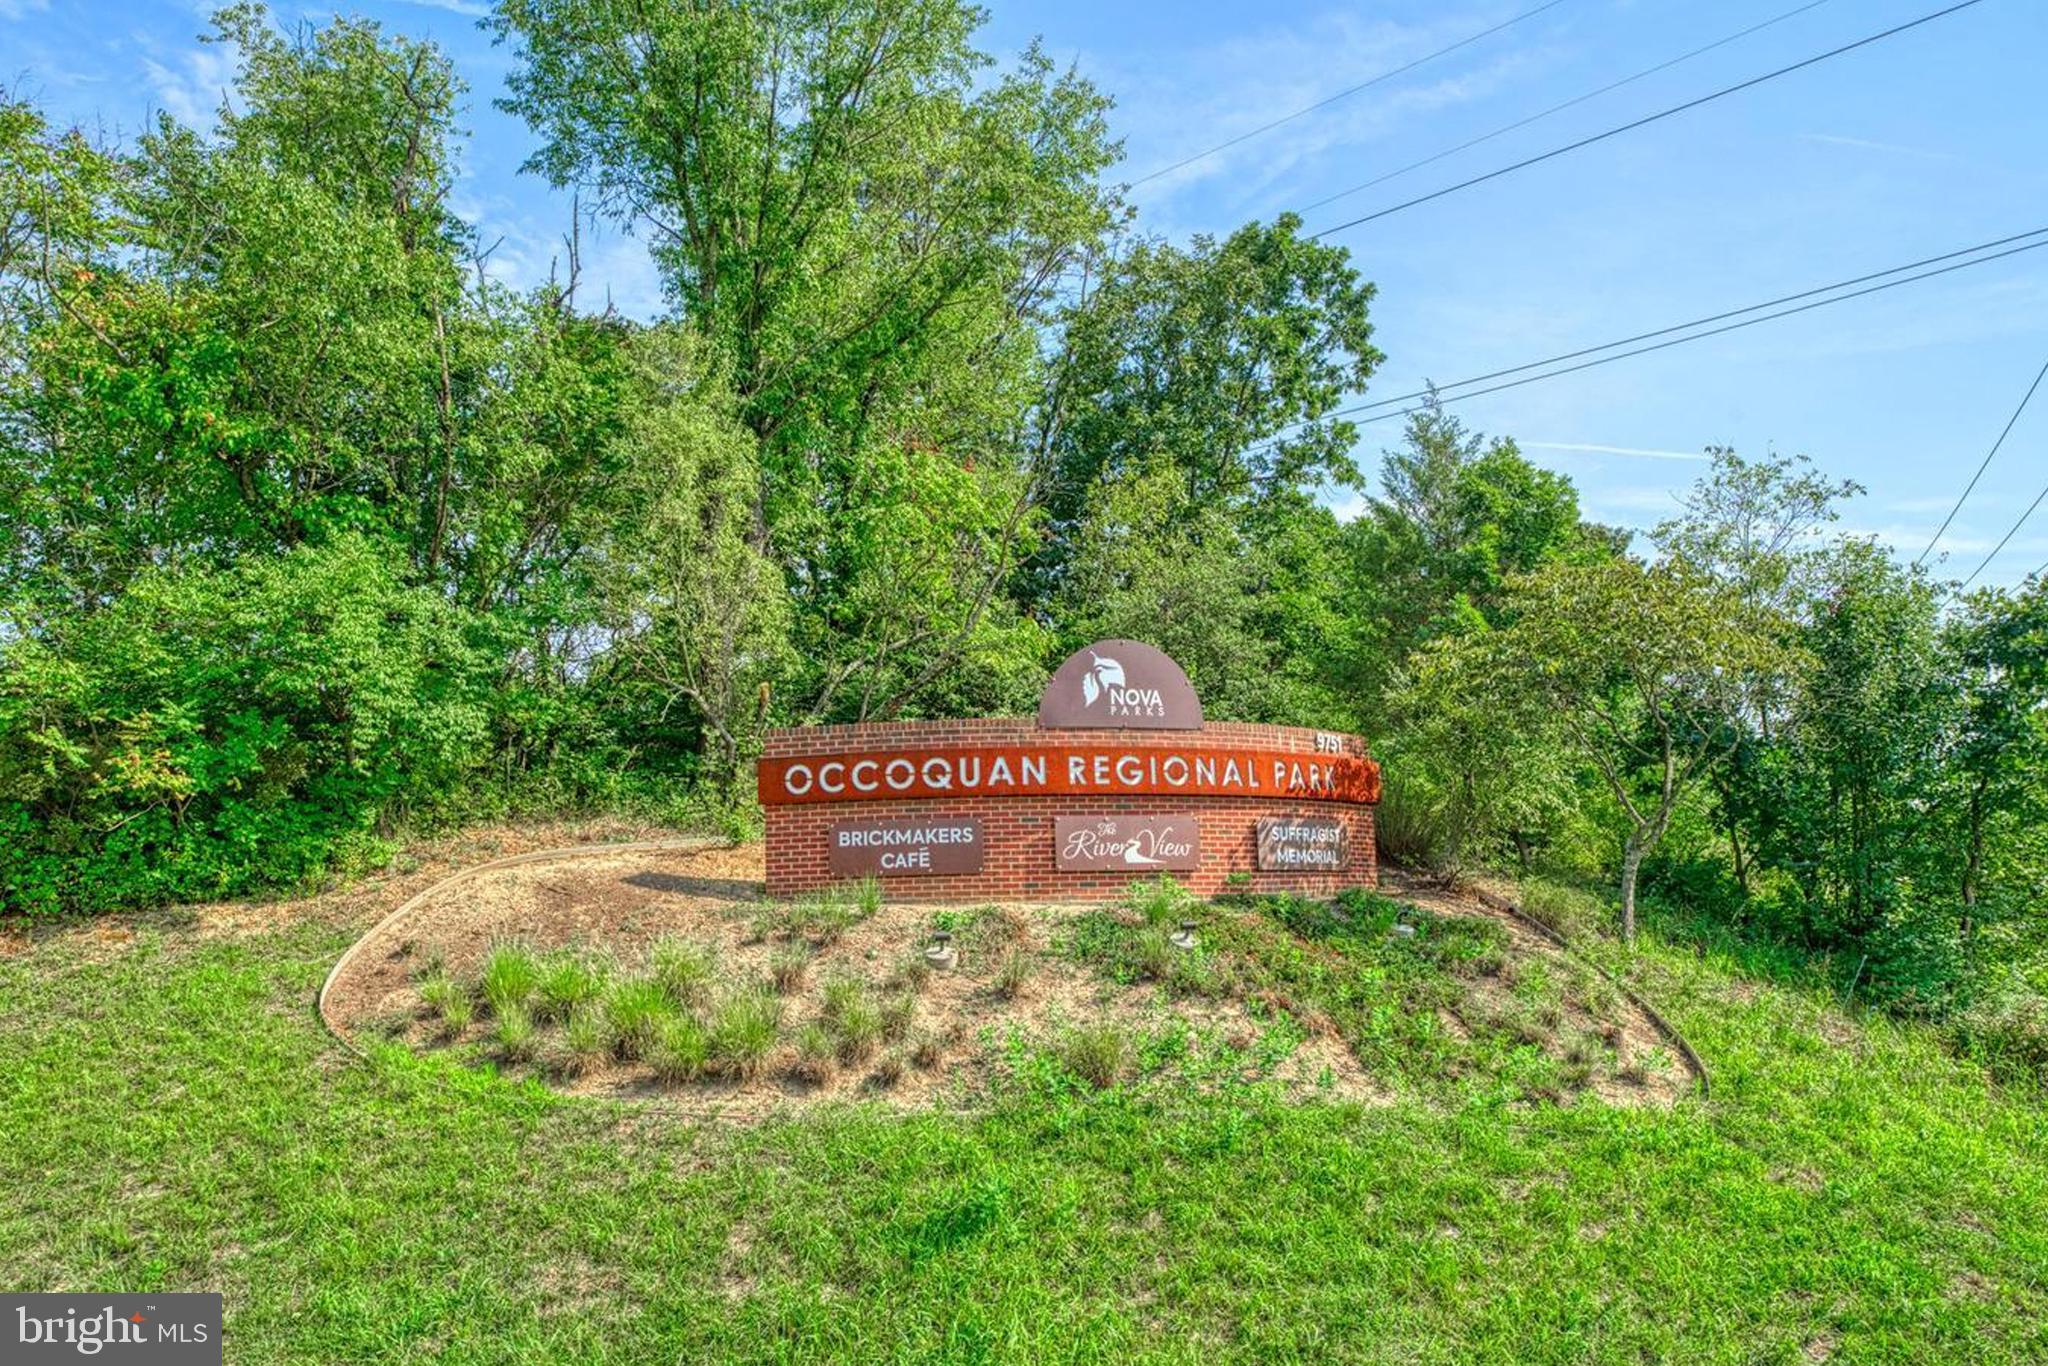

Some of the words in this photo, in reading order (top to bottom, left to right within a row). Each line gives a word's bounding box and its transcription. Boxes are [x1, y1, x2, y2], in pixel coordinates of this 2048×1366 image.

[1110, 688, 1164, 707] NOVA
[1110, 705, 1166, 717] PARKS
[1316, 731, 1343, 754] 9751
[784, 755, 1047, 796] OCCOQUAN
[1068, 755, 1260, 788] REGIONAL
[1274, 760, 1336, 792] PARK
[838, 827, 974, 847] BRICKMAKERS
[1271, 825, 1342, 843] SUFFRAGIST
[880, 847, 931, 869] CAFÉ
[1277, 848, 1341, 865] MEMORIAL
